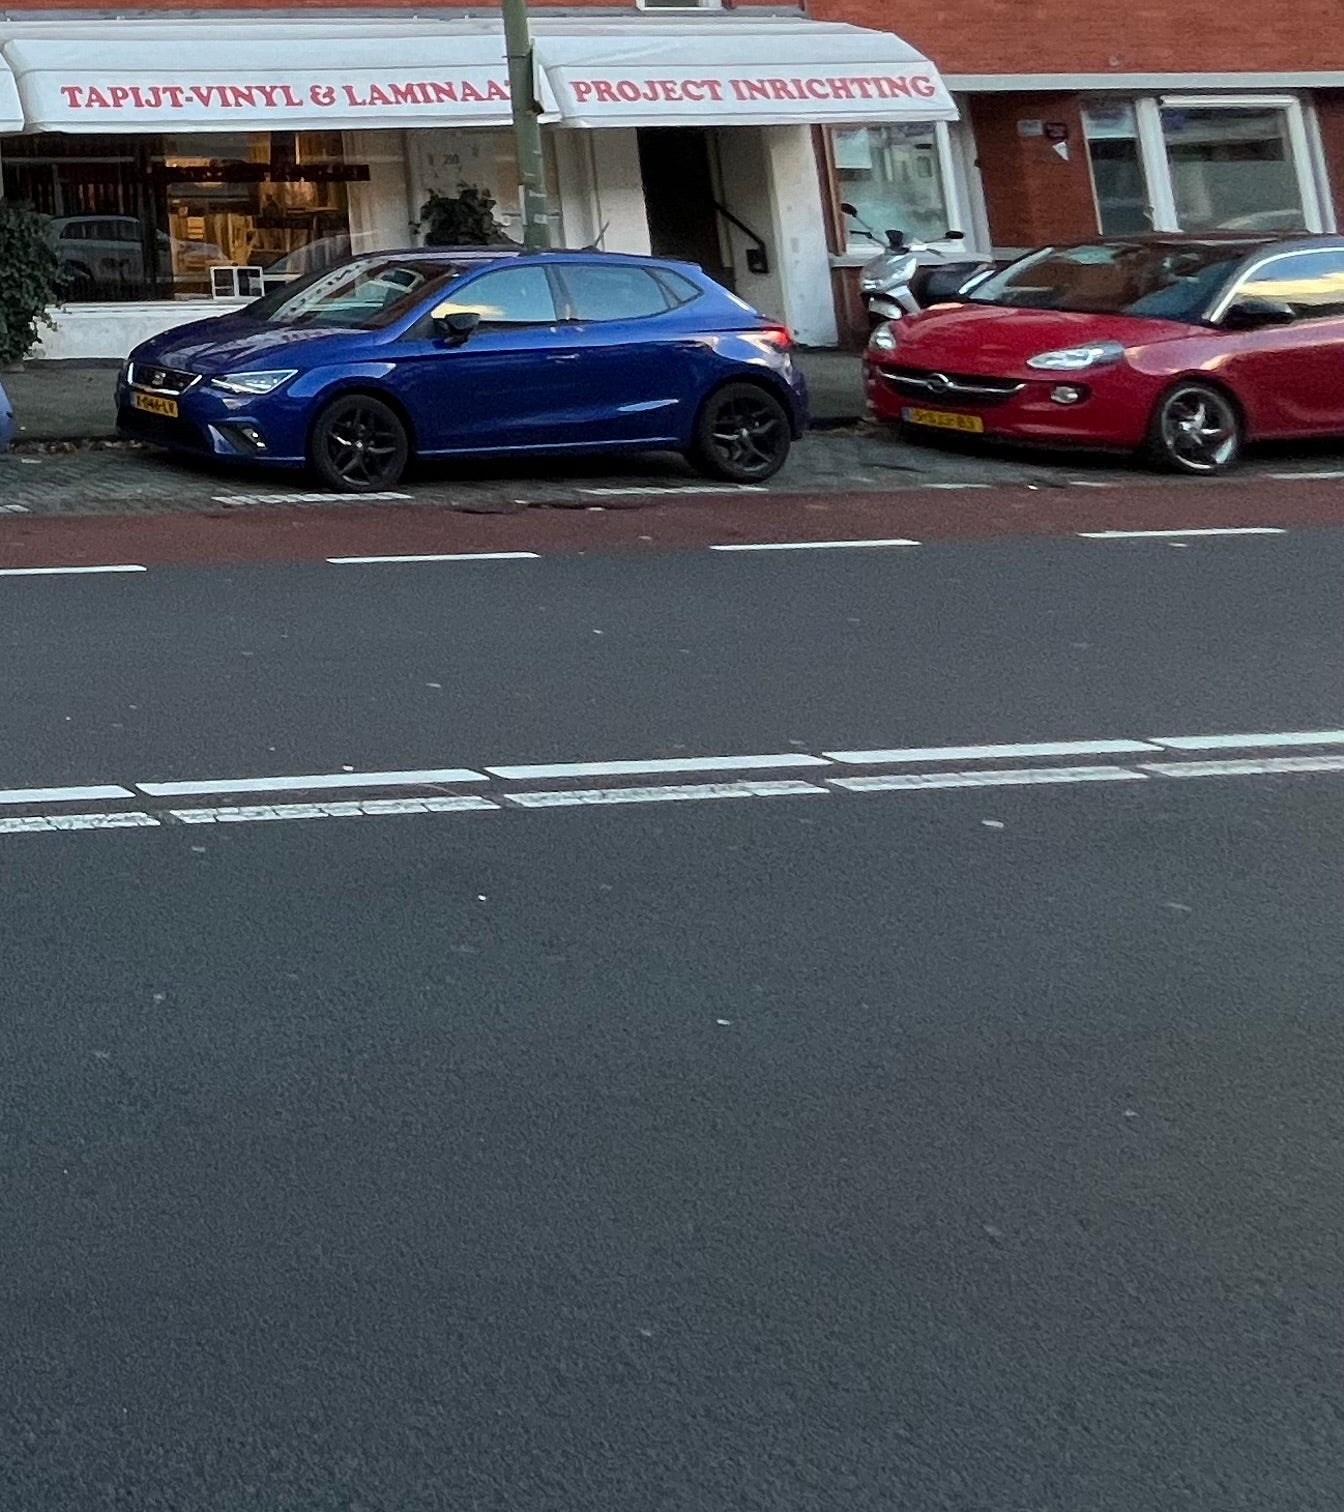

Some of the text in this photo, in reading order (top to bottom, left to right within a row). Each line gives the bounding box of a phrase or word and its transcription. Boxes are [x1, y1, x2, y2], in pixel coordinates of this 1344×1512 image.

[59, 79, 511, 108] TAPIJT-VINYL & LAMINAA
[568, 75, 936, 104] PROJECT INRICHTING
